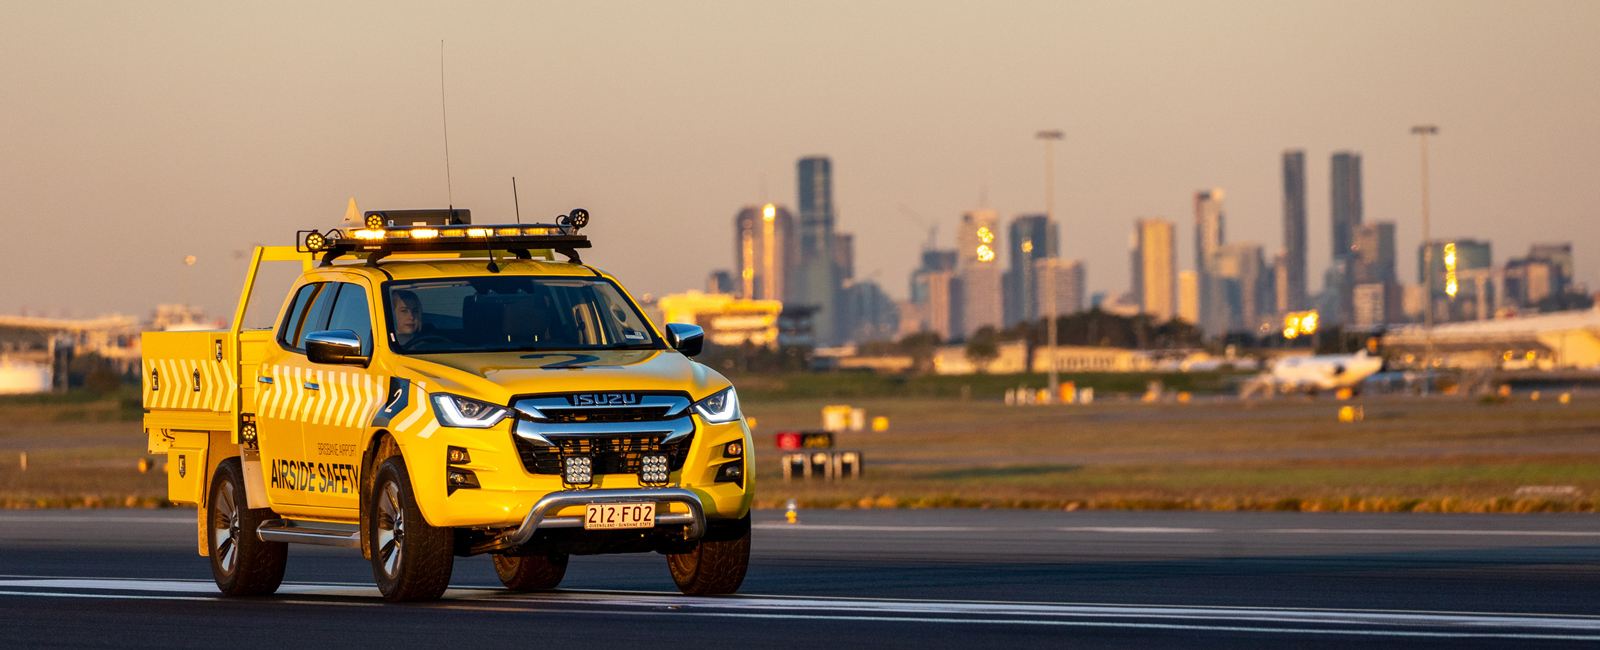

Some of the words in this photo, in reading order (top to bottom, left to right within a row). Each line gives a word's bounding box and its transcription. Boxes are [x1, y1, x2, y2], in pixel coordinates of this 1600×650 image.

[384, 388, 402, 413] 2
[573, 393, 636, 405] ISUZU
[317, 443, 339, 456] BRISBANE
[339, 444, 357, 457] AIRPORT
[271, 459, 316, 492] AIRSIDE
[318, 463, 360, 494] SAFETY
